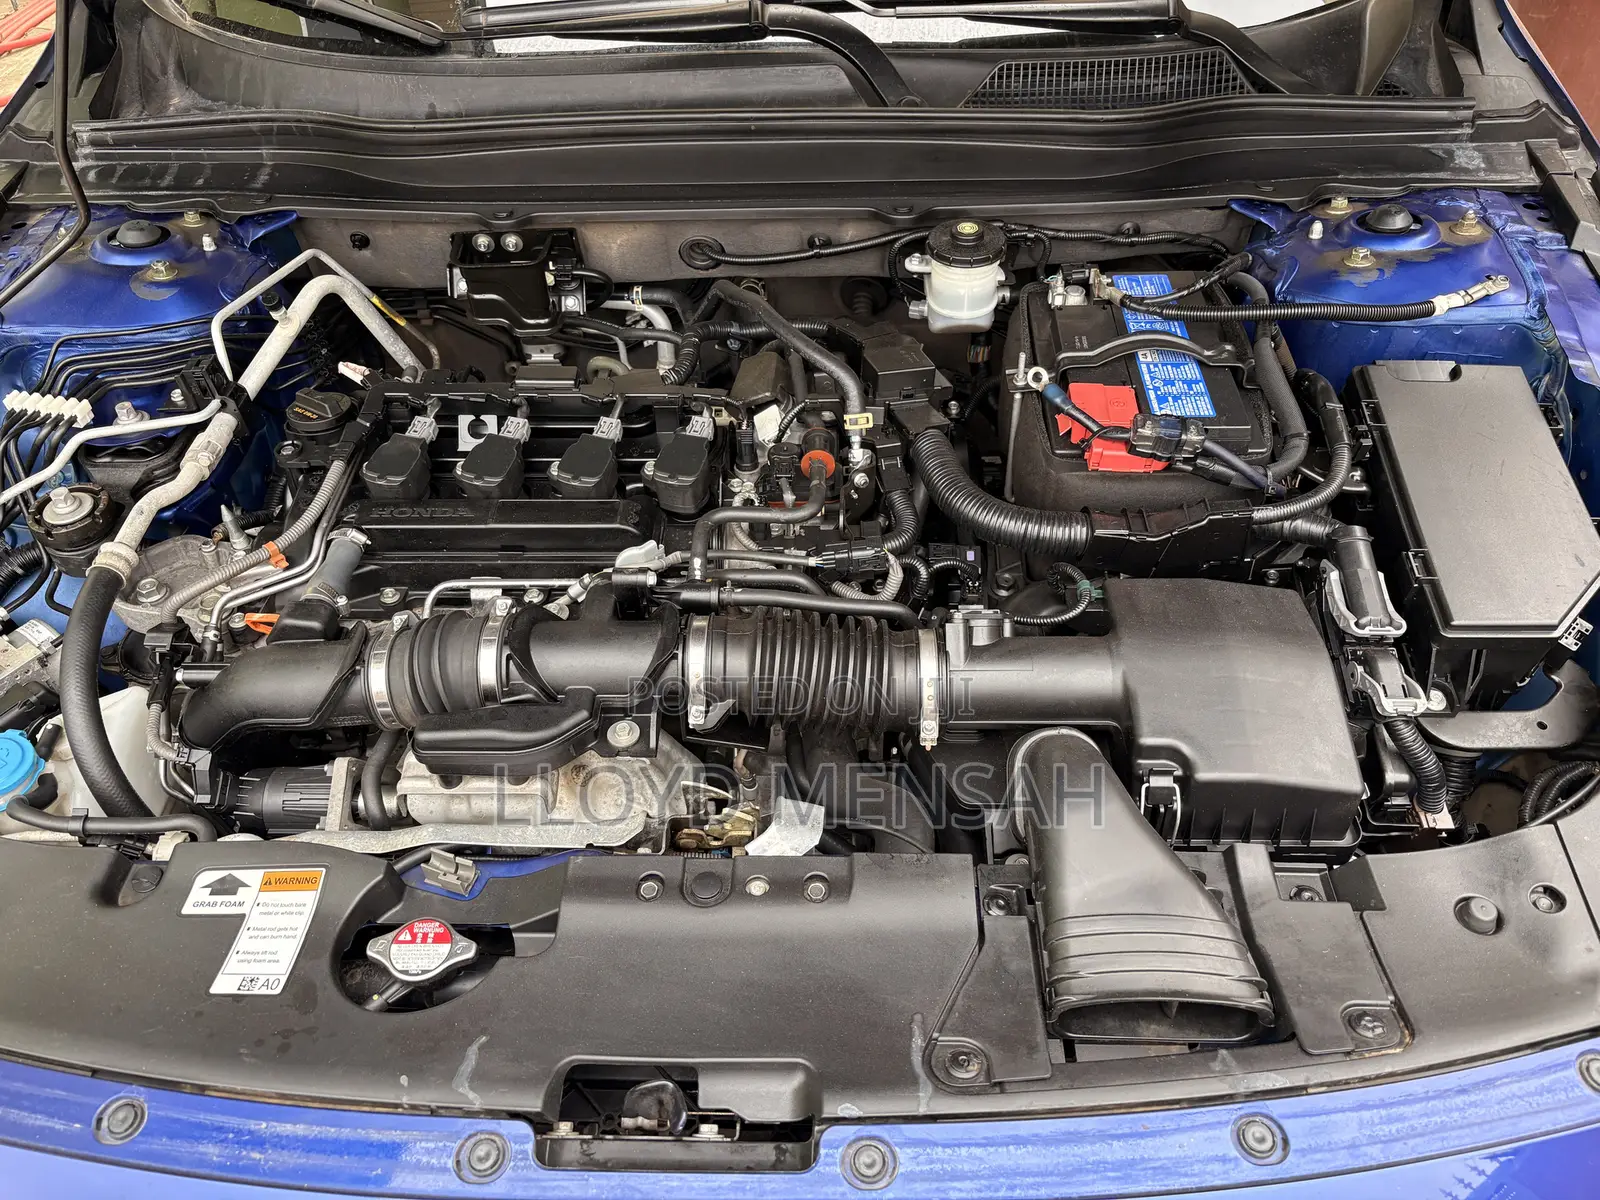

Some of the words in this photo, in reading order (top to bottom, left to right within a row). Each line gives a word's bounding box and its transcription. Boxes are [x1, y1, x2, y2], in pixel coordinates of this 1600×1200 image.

[369, 507, 475, 518] HONDA
[274, 876, 318, 886] WARNING
[192, 900, 219, 908] GRAB
[219, 900, 246, 908] FOAM
[258, 978, 281, 991] A0
